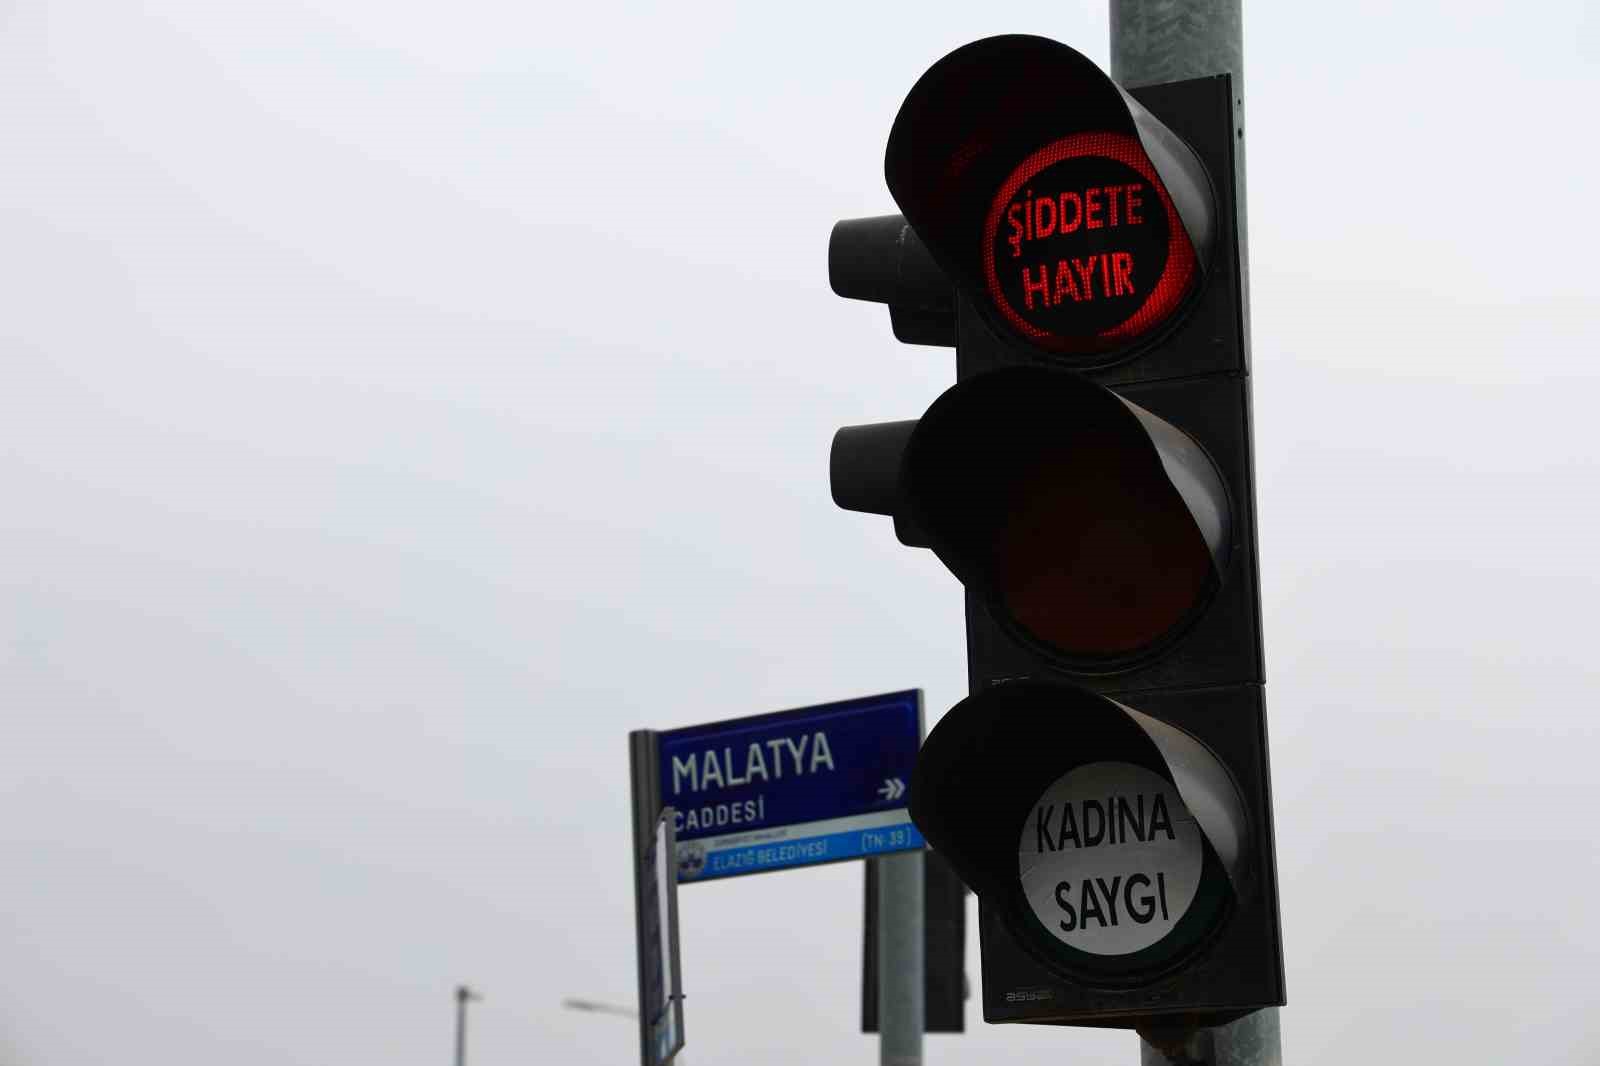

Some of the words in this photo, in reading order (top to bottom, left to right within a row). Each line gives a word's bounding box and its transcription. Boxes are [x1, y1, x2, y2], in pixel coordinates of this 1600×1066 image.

[1007, 183, 1145, 257] ŞİDDETE
[1022, 252, 1136, 310] HAYIR
[671, 731, 835, 796] MALATYA
[673, 795, 765, 833] CADDESİ
[1036, 792, 1177, 854] KADINA
[1054, 872, 1169, 932] SAYGI
